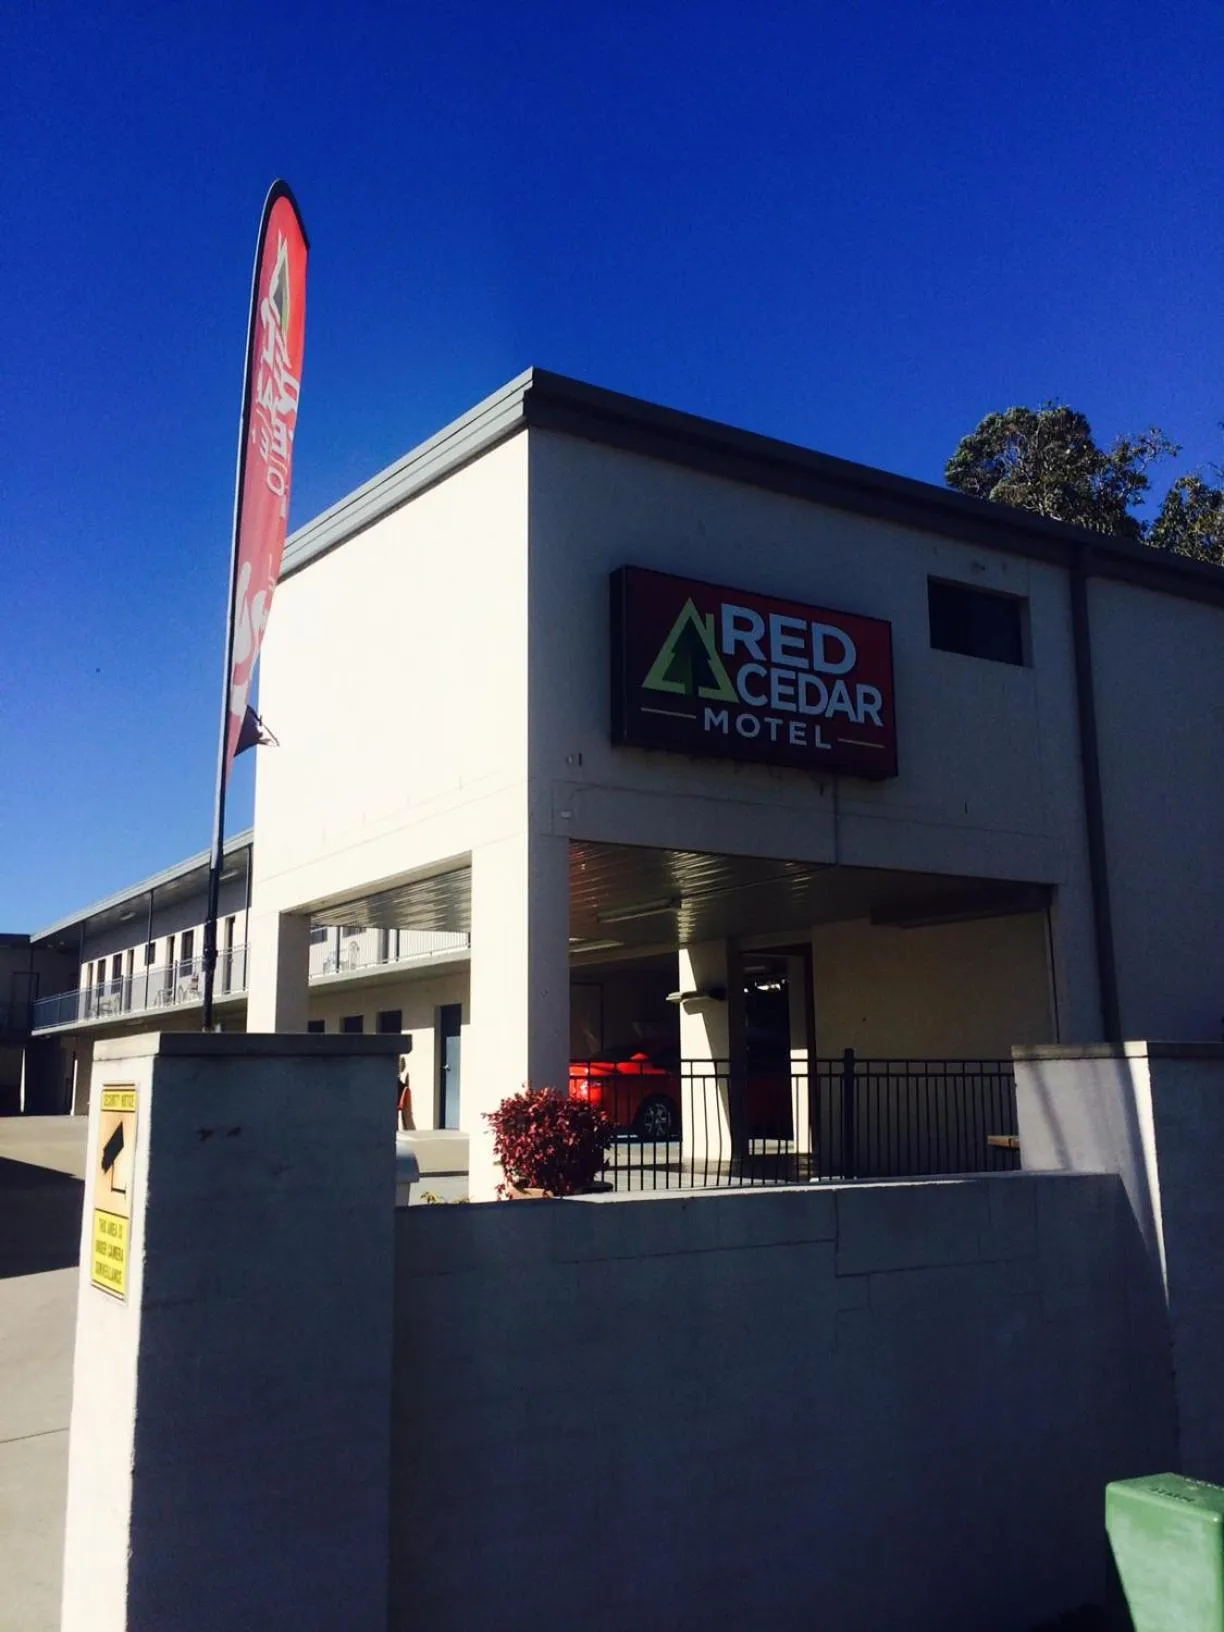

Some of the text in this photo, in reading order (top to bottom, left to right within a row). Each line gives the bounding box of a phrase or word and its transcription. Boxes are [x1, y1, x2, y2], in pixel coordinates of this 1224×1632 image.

[720, 602, 857, 675] RED
[736, 662, 884, 727] CEDAR
[704, 707, 832, 749] MOTEL
